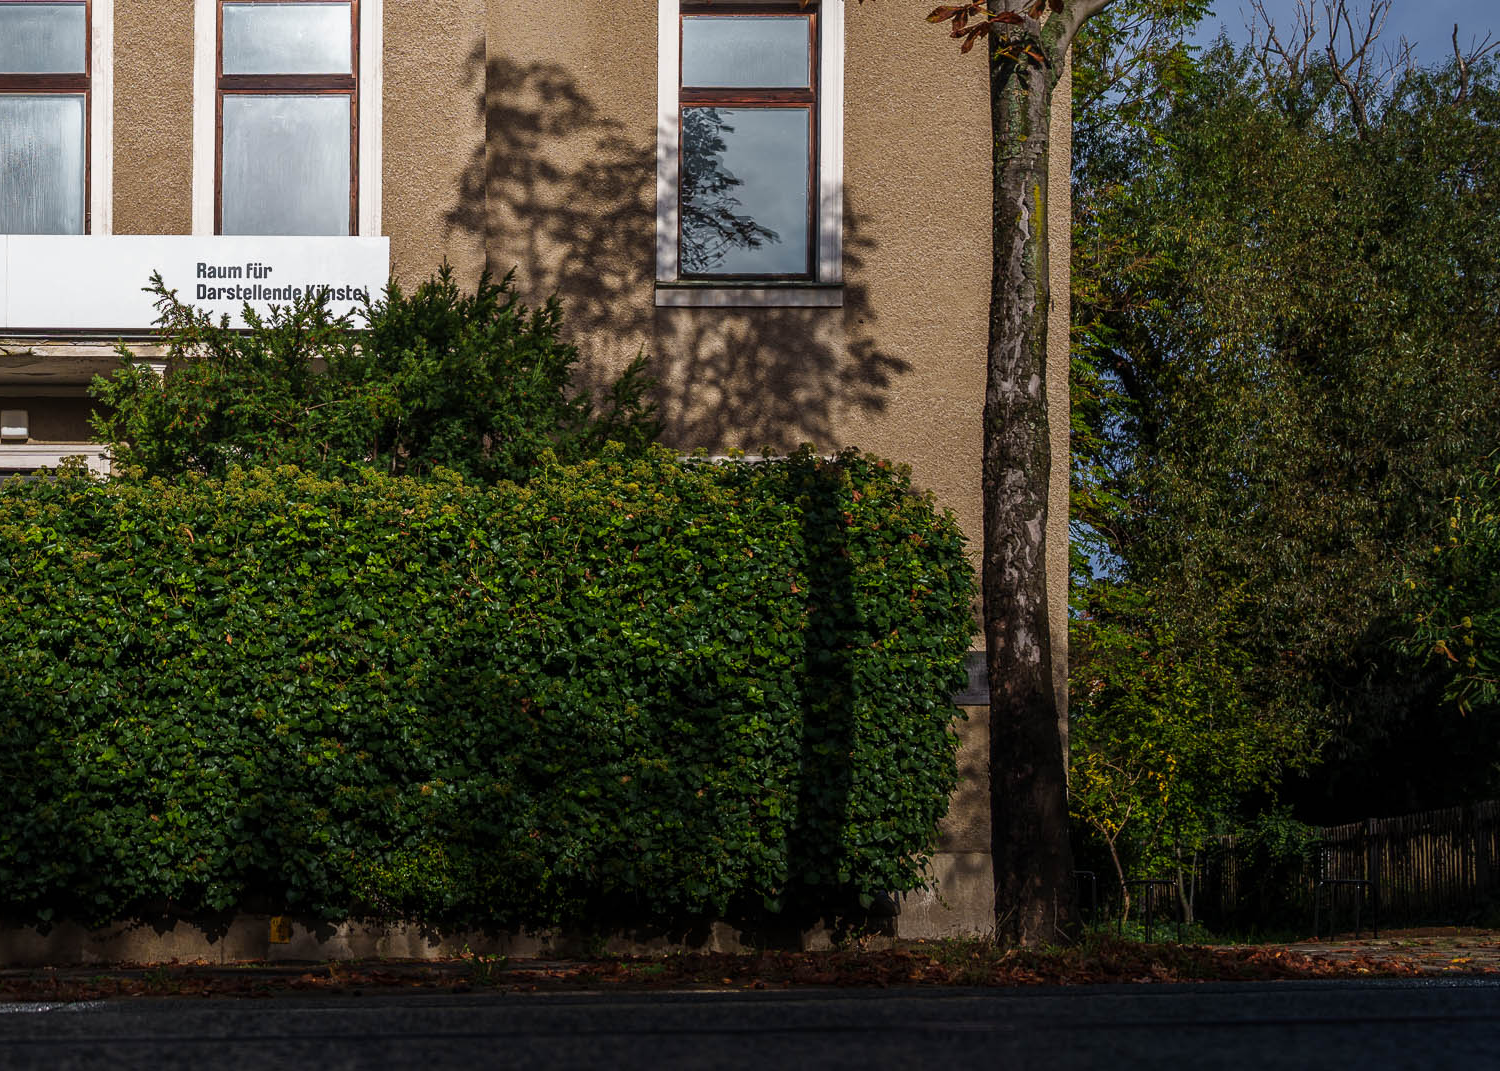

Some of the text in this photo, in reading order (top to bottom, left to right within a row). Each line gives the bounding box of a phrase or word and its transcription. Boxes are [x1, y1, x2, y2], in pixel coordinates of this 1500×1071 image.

[197, 263, 273, 279] Raum für
[196, 284, 301, 301] Darstellende
